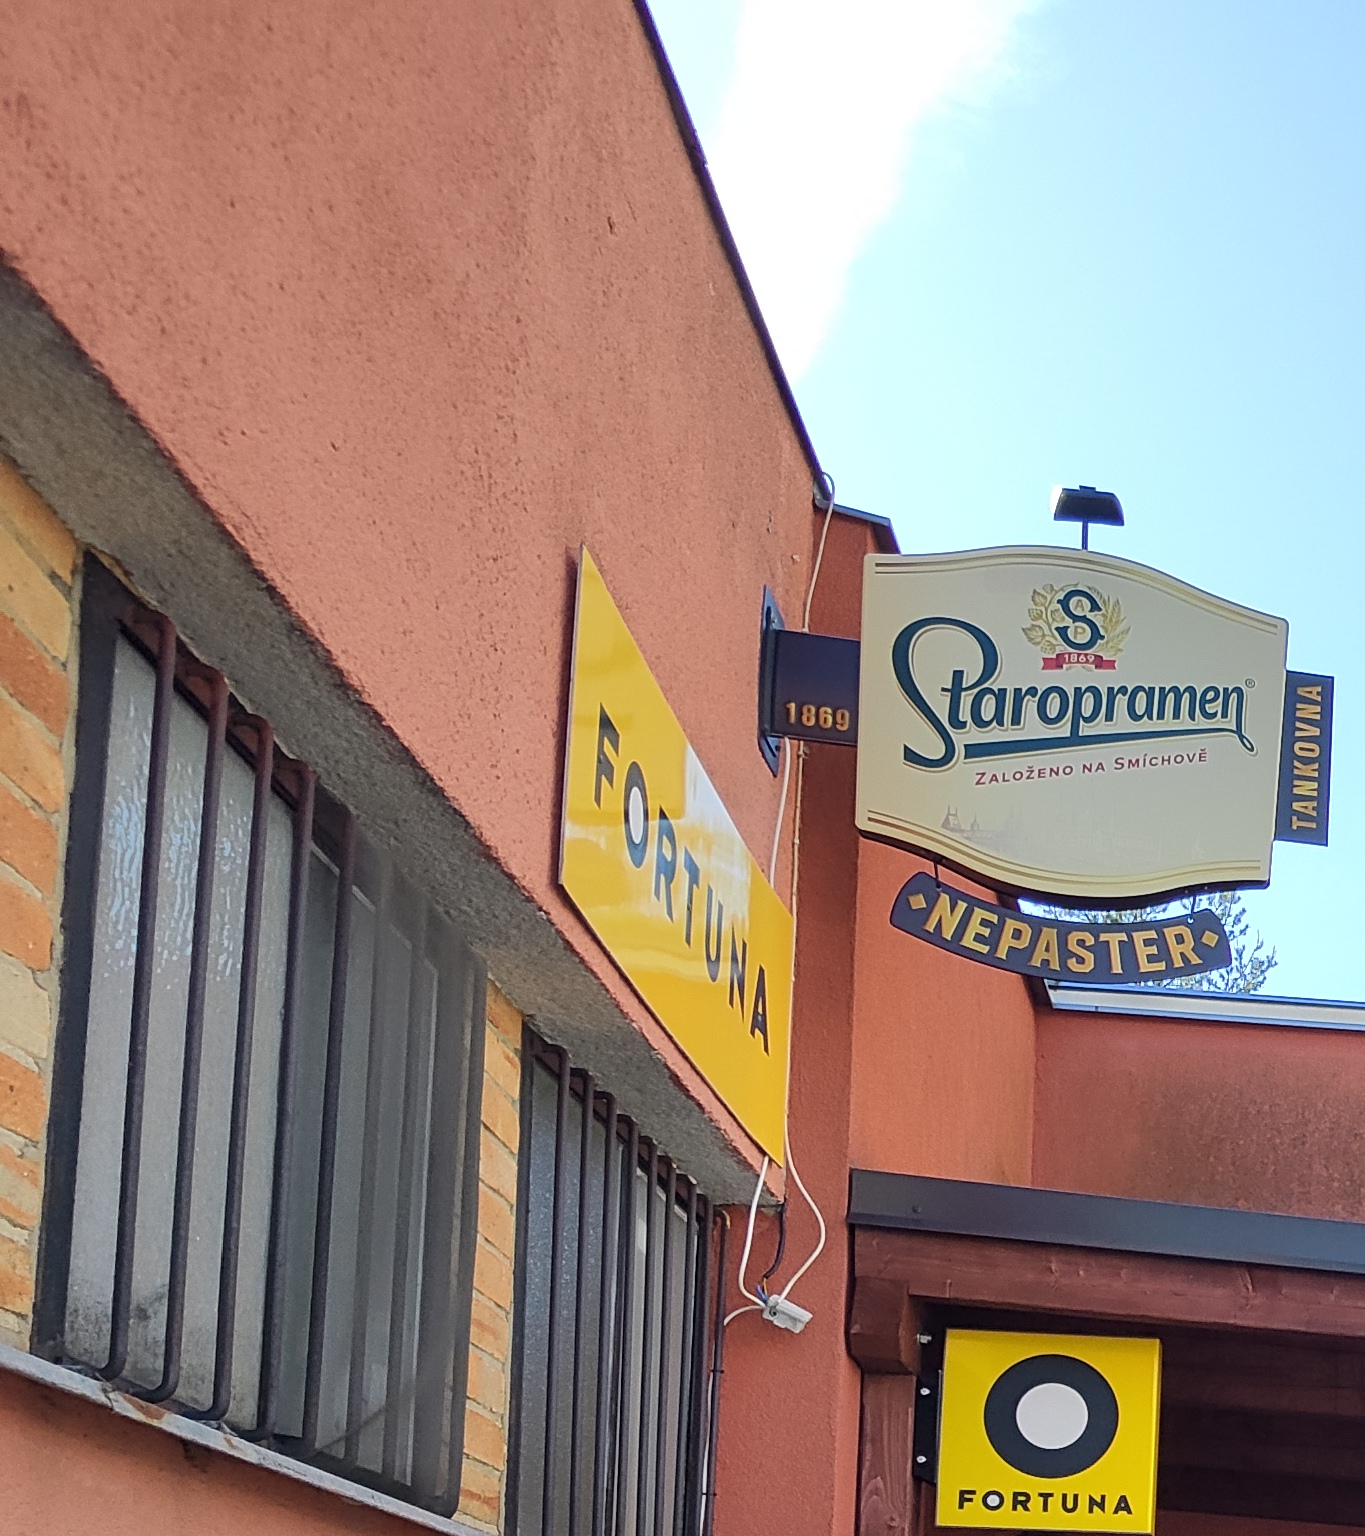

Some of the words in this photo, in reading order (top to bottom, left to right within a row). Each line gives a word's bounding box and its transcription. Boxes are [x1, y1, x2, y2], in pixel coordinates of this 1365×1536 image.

[892, 616, 1255, 768] Staropramen
[1063, 653, 1095, 663] 1869
[785, 701, 851, 732] 1869
[1291, 684, 1323, 832] TANKOVNA
[593, 702, 771, 1057] FORTUNA
[923, 892, 1203, 975] NEPASTER
[957, 1489, 1133, 1516] FORTUNA
